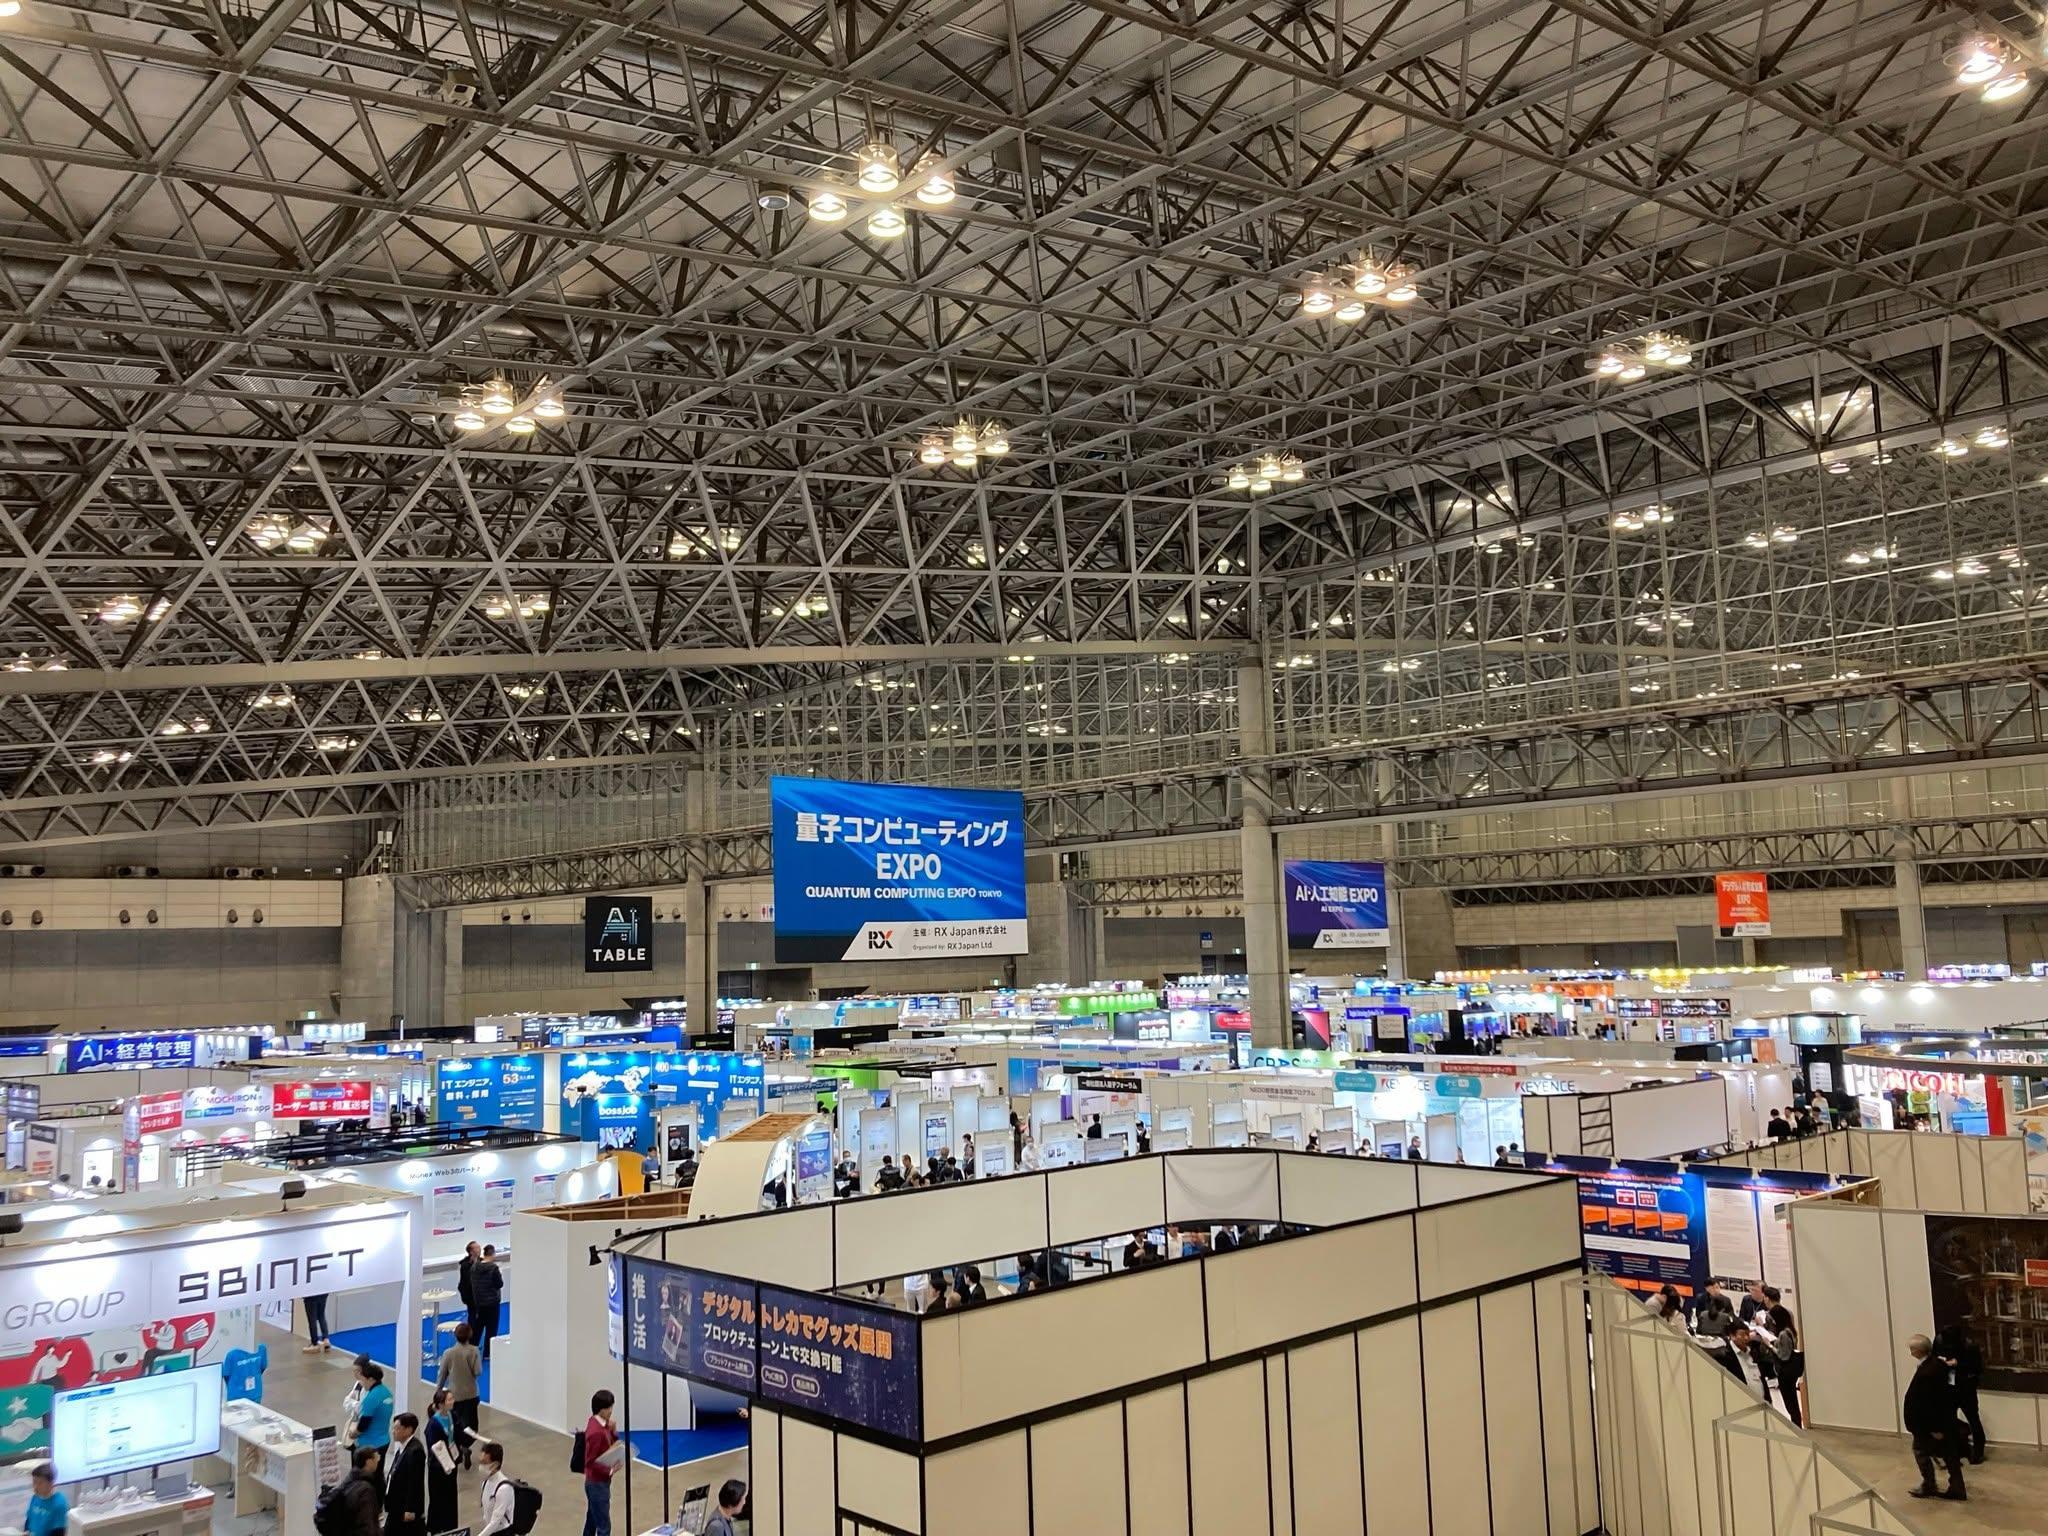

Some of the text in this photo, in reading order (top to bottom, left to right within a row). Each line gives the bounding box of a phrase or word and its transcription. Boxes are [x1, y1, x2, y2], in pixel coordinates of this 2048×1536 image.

[796, 812, 1009, 847] 量子コンピューティング
[876, 853, 941, 880] EXPO
[805, 886, 1002, 899] QUANTUM COMPUTING EXPO TOKYO
[1349, 887, 1379, 902] EXPO
[868, 930, 893, 949] RX
[934, 927, 947, 936] RX
[592, 948, 646, 962] TABLE
[958, 942, 980, 951] Japan
[1515, 1080, 1576, 1093] KEYENCE
[599, 1104, 638, 1116] bossjob
[178, 1247, 365, 1304] SBINFT
[5, 1290, 126, 1331] GROUP
[631, 1272, 647, 1349] 推し活
[703, 1323, 843, 1375] ブロックチェーン上で交換可能
